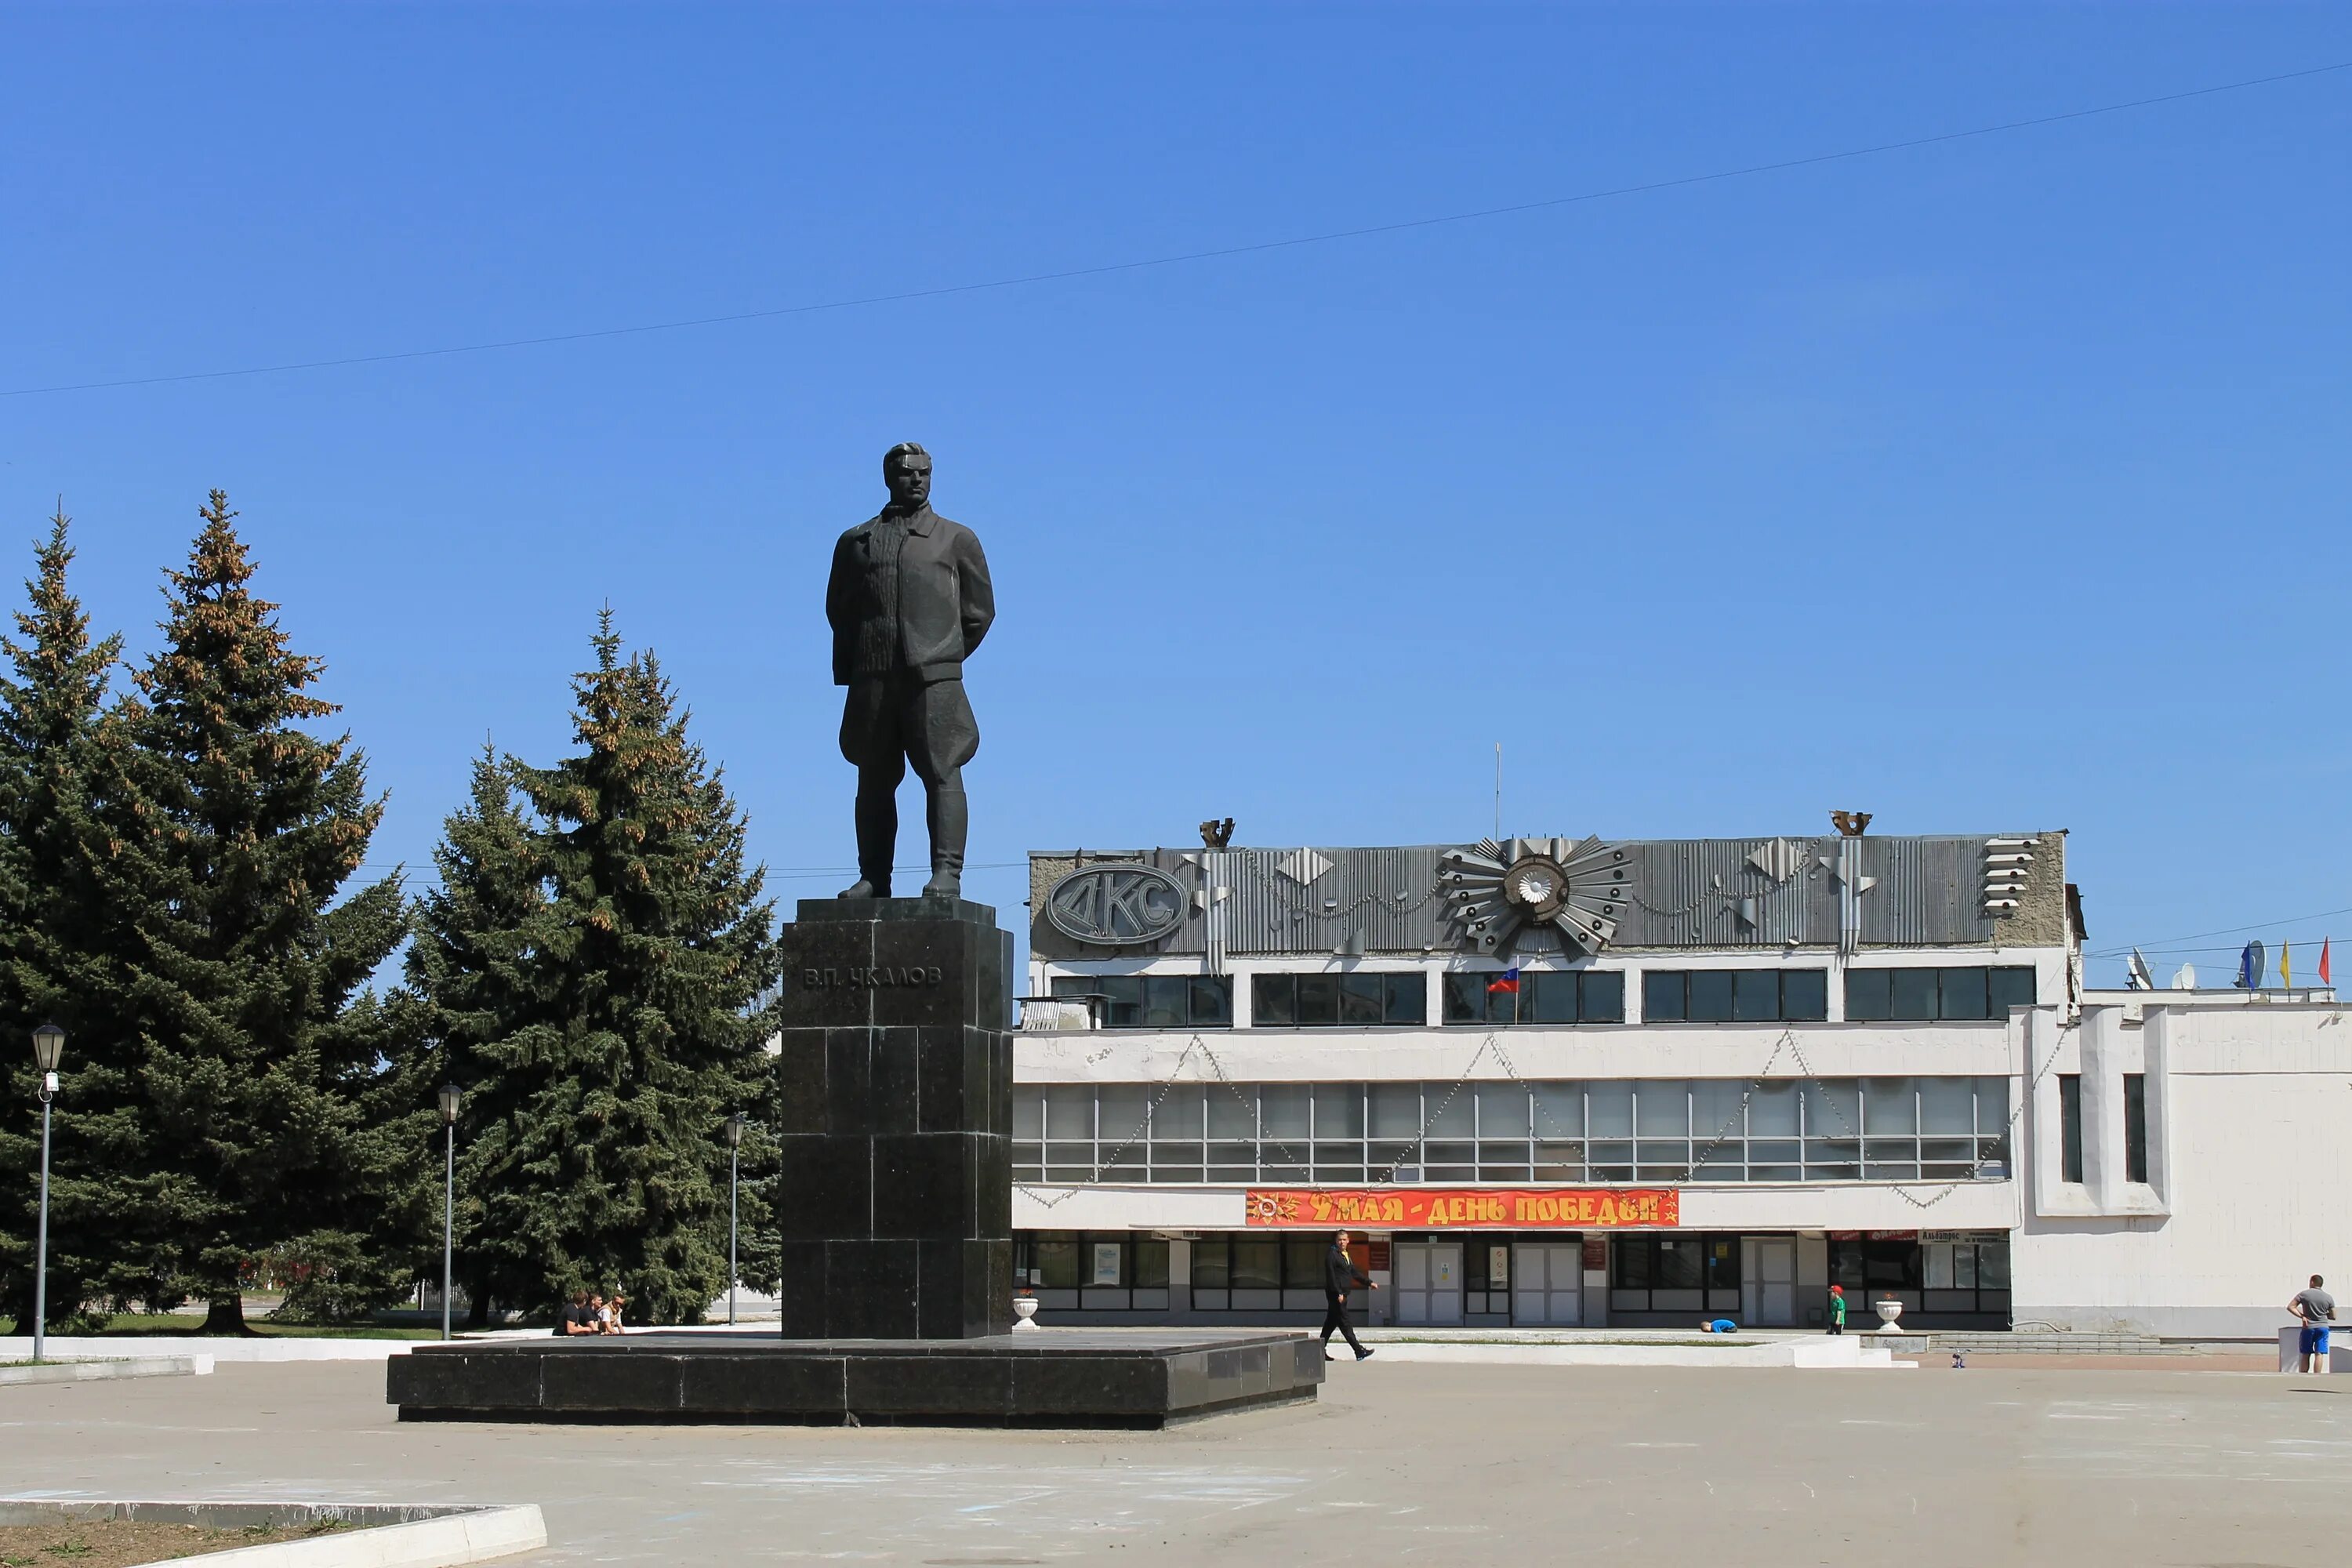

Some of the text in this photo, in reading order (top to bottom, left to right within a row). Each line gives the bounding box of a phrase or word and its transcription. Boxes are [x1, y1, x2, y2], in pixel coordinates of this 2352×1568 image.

[1057, 873, 1174, 936] ДКС
[804, 967, 942, 985] В.П. ЧКАЛОВ
[1308, 1192, 1659, 1225] 9 МАЯ - ДЕНЬ ПОБЕДЫ!
